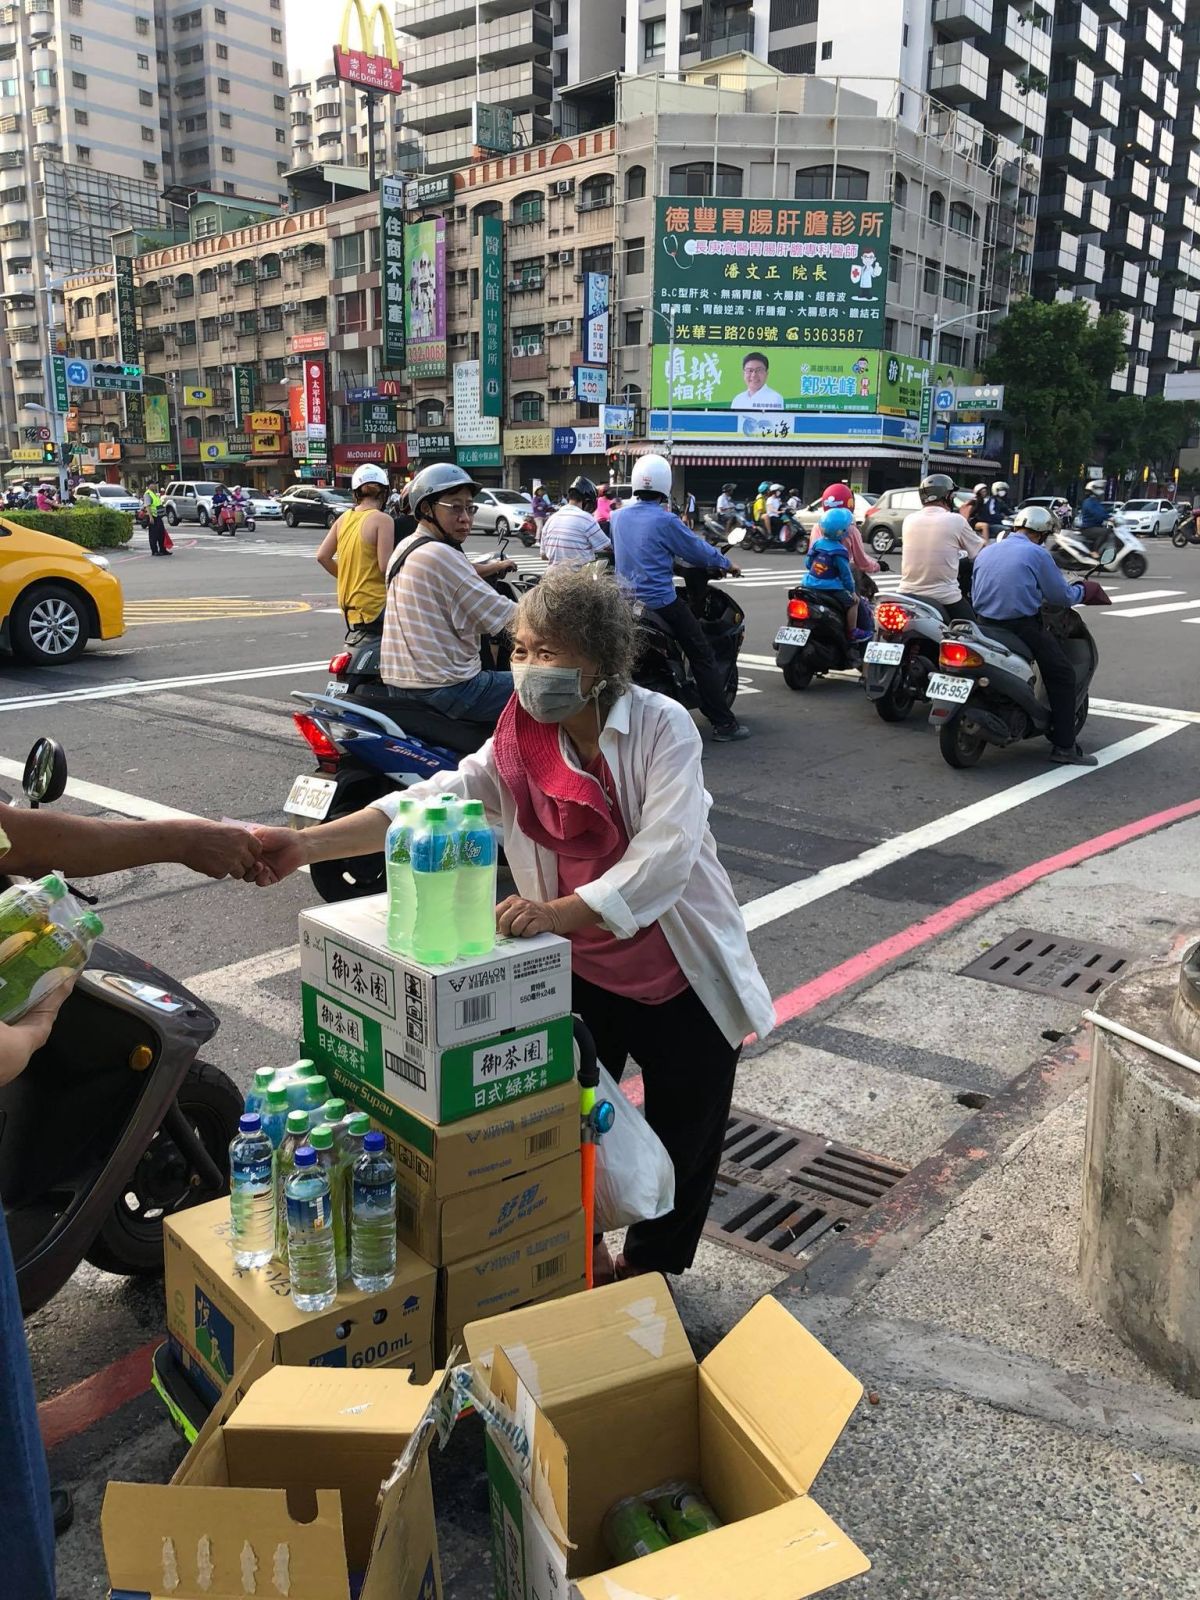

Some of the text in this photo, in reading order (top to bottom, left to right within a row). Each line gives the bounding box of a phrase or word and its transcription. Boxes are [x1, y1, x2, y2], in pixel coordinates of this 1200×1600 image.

[350, 57, 393, 80] 麥當勞
[350, 68, 394, 89] McDonald's
[665, 206, 884, 238] 德豐胃腸肝膽診所
[695, 239, 859, 259] 長庚高醫胃腸肝膽專科醫師
[385, 216, 403, 324] 住商不動產
[724, 262, 828, 281] 潘文正 院長
[676, 324, 864, 343] 光華三路269號 5363587
[582, 382, 598, 393] 100
[801, 375, 857, 398] 鄭光峰
[365, 424, 397, 433] 332-0068
[347, 451, 381, 459] McDonald's
[928, 681, 970, 700] AK5-952
[332, 951, 388, 1006] 御茶園
[468, 966, 506, 982] VITALON
[321, 1004, 360, 1043] 御茶園
[481, 1040, 541, 1076] 御茶園
[333, 1068, 394, 1117] Super Supau
[474, 1070, 540, 1108] 日式綠茶
